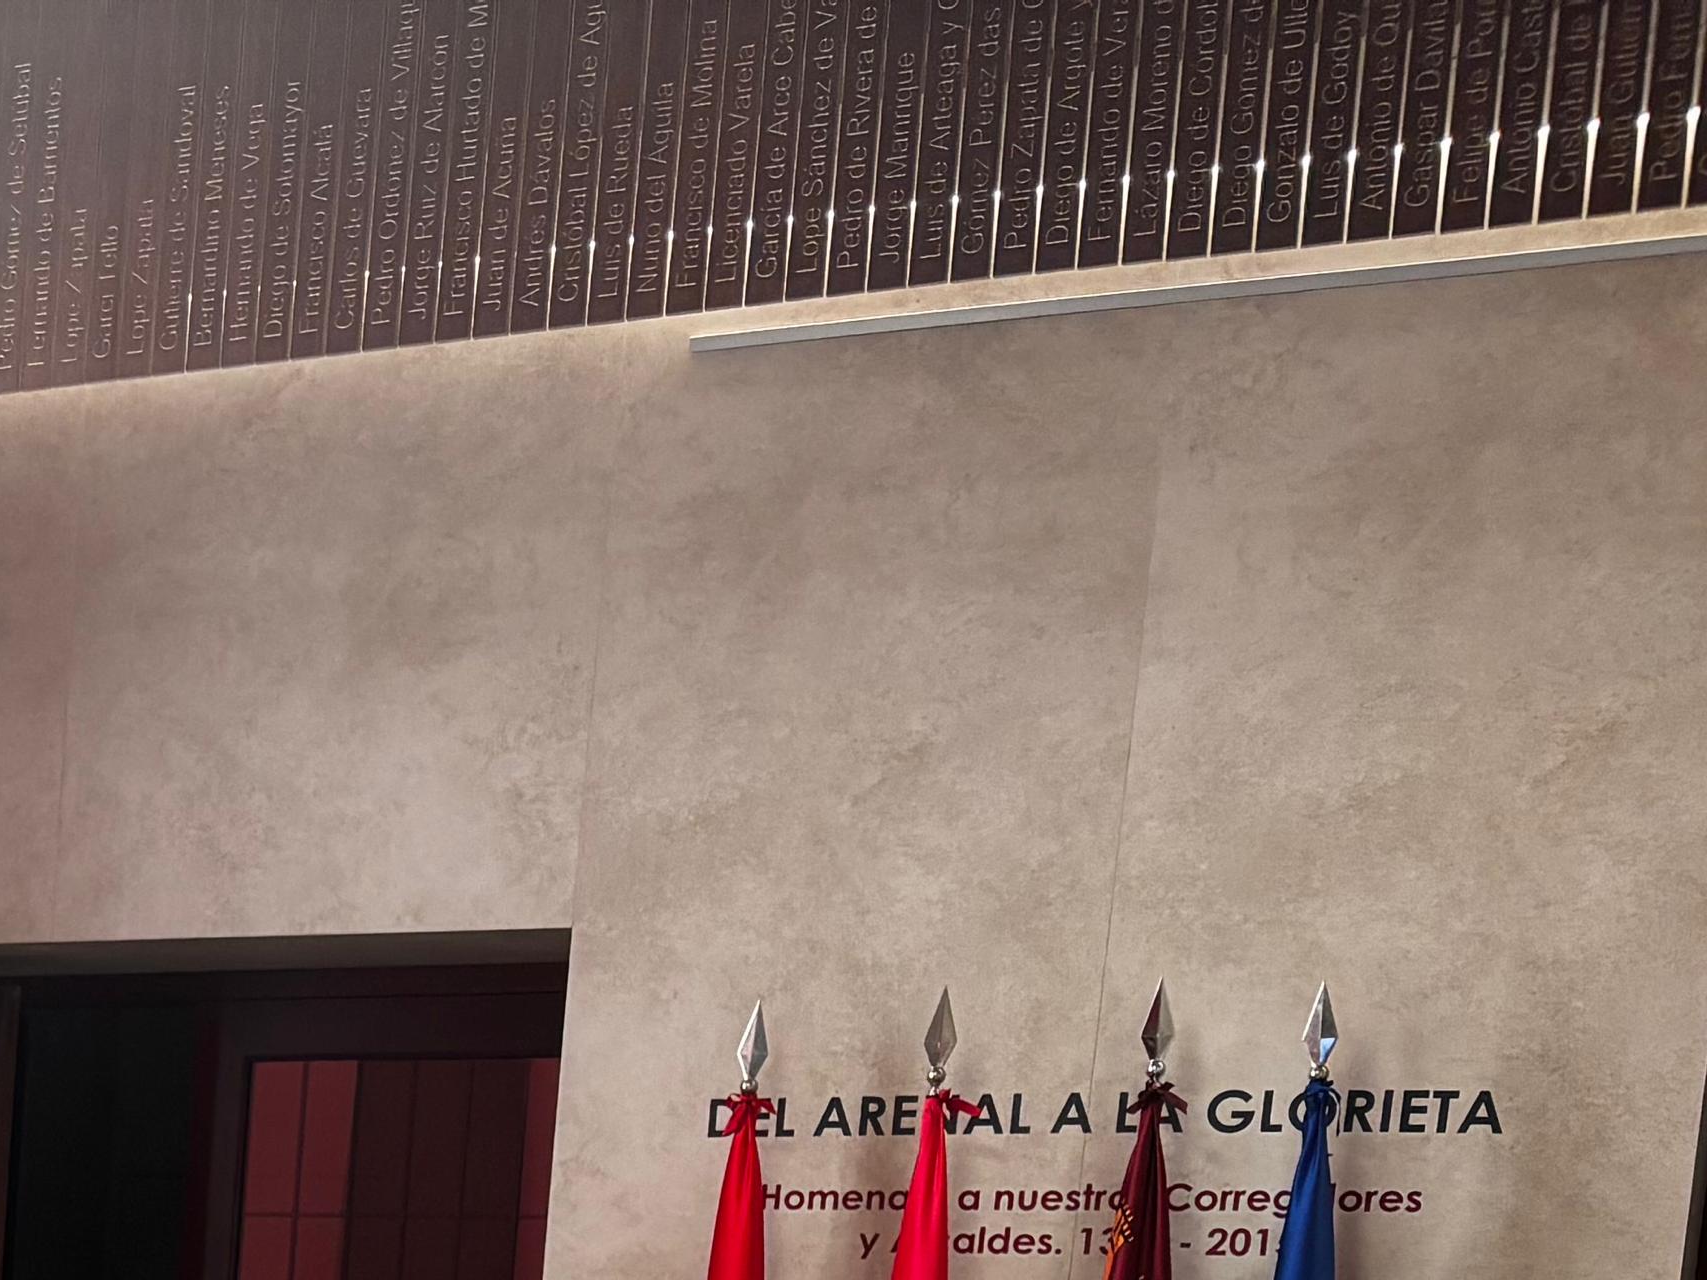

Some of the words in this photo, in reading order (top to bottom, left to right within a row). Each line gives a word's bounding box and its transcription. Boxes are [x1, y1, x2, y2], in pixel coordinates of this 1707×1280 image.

[465, 37, 486, 68] de
[813, 37, 835, 70] de
[856, 6, 878, 39] de
[942, 20, 964, 34] y
[977, 7, 1001, 56] das
[1019, 19, 1043, 52] de
[1321, 11, 1358, 104] Godoy
[577, 55, 599, 87] de
[691, 19, 717, 107] Molina
[728, 43, 755, 131] Varela
[846, 50, 874, 136] Rivera
[928, 44, 959, 150] Arteaga
[1056, 20, 1086, 111] Argote
[1095, 65, 1119, 98] de
[1141, 25, 1172, 131] Moreno
[1277, 60, 1303, 94] de
[1371, 57, 1396, 91] de
[1466, 68, 1490, 102] de
[170, 84, 196, 202] Sandoval
[205, 85, 229, 200] Meneses
[241, 103, 265, 170] Vega
[345, 88, 372, 198] Guevara
[456, 78, 483, 182] Hurtado
[568, 99, 597, 177] López
[688, 117, 710, 148] de
[766, 76, 792, 136] Arce
[800, 80, 832, 197] Sánchez
[884, 52, 918, 179] Manrique
[1010, 62, 1042, 158] Zapata
[1055, 121, 1077, 154] de
[1188, 107, 1209, 140] de
[1321, 115, 1344, 149] de
[1501, 83, 1536, 193] Antonio
[6, 165, 25, 194] de
[272, 80, 304, 216] Sotomayor
[420, 142, 440, 173] de
[492, 116, 517, 198] Acuña
[606, 105, 633, 193] Rueda
[764, 147, 786, 179] de
[844, 146, 867, 179] de
[925, 162, 948, 194] de
[1087, 108, 1121, 241] Fernando
[1267, 104, 1299, 222] Gonzalo
[1359, 101, 1391, 210] Antonio
[1404, 102, 1443, 207] Gaspar
[1453, 116, 1489, 203] Felipe
[239, 178, 258, 209] de
[343, 207, 362, 238] de
[371, 249, 395, 325] Pedro
[388, 88, 408, 120] de
[413, 184, 437, 240] Ruiz
[603, 203, 625, 234] de
[645, 174, 666, 212] del
[676, 158, 706, 287] Francisco
[715, 139, 749, 283] Licenciado
[1003, 168, 1033, 250] Pedro
[1046, 165, 1079, 244] Diego
[1133, 141, 1162, 236] Lázaro
[1178, 151, 1210, 232] Diego
[1222, 145, 1254, 227] Diego
[1313, 160, 1342, 217] Luis
[35, 212, 54, 242] de
[168, 211, 187, 241] de
[269, 226, 289, 256] de
[443, 191, 473, 315] Francisco
[489, 208, 509, 240] de
[519, 214, 547, 306] Andrés
[557, 187, 587, 301] Cristóbal
[754, 189, 783, 278] García
[795, 207, 825, 274] Lope
[836, 188, 865, 269] Pedro
[879, 189, 907, 264] Jorge
[919, 203, 944, 260] Luis
[194, 209, 221, 346] Bernardino
[229, 218, 256, 341] Hernando
[264, 264, 288, 338] Diego
[299, 211, 326, 333] Francisco
[334, 247, 359, 329] Carlos
[408, 250, 435, 319] Jorge
[482, 250, 505, 311] Juan
[599, 244, 621, 298] Luis
[1050, 1092, 1092, 1135] A
[762, 1184, 909, 1212] Homena
[958, 1189, 981, 1211] a
[1167, 1182, 1423, 1219] Corregores
[859, 1232, 881, 1260] y
[1205, 1227, 1279, 1257] 201
